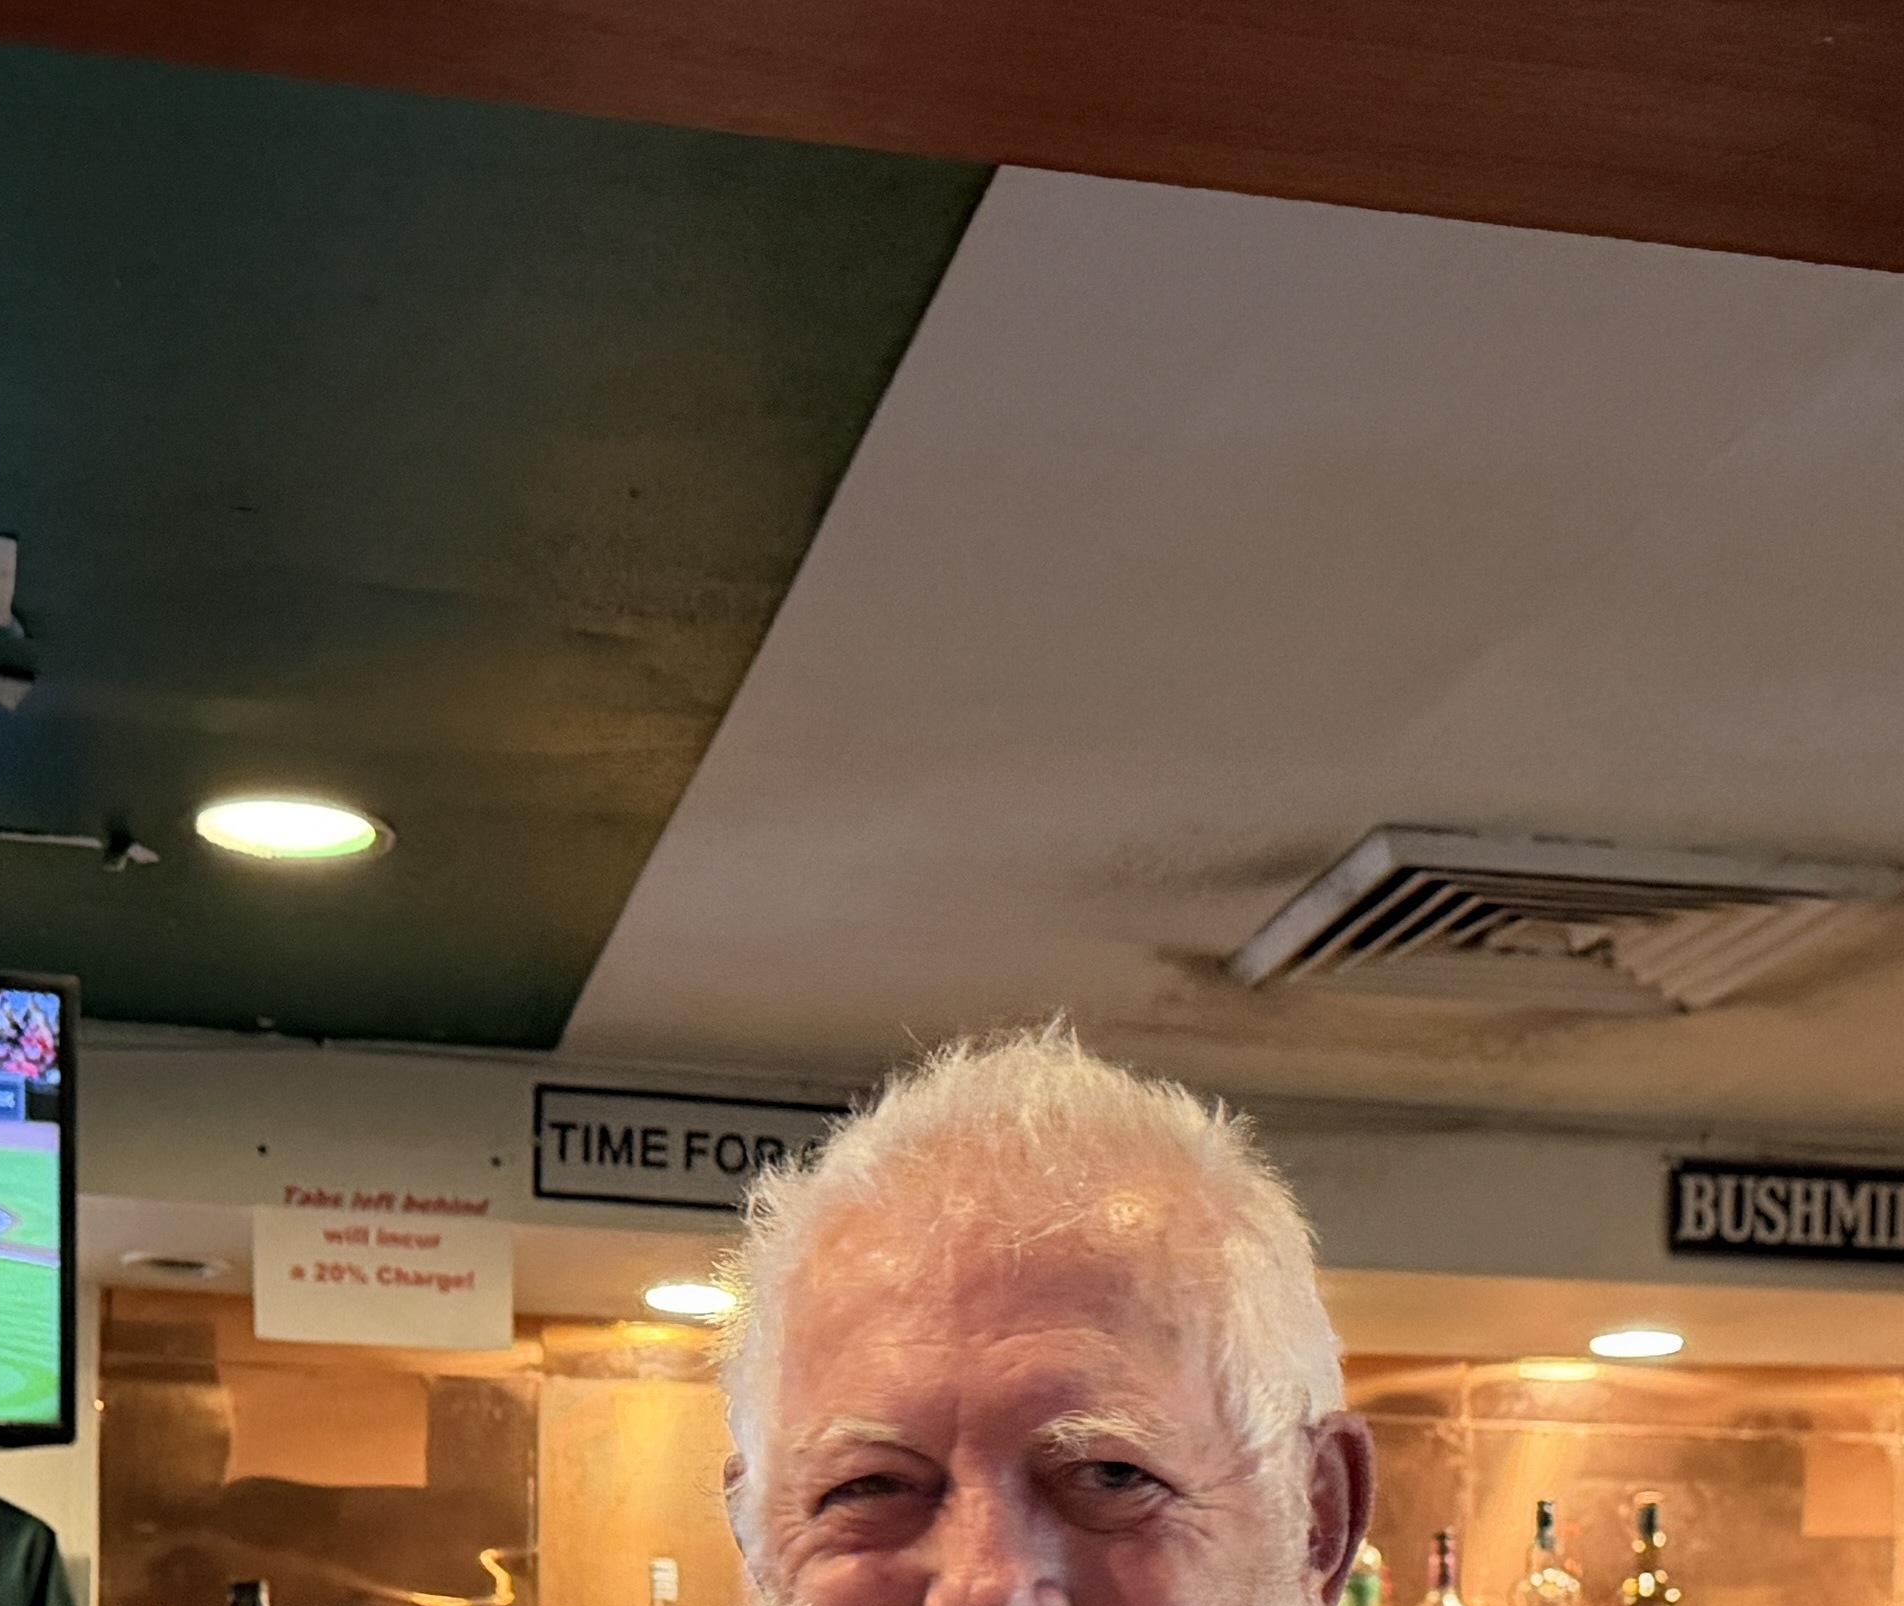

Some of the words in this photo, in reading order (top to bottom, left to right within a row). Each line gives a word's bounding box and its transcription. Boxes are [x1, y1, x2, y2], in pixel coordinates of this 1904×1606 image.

[549, 1121, 669, 1170] TIME
[685, 1130, 786, 1176] FOR
[401, 1187, 491, 1216] behind
[323, 1224, 370, 1247] will
[376, 1226, 442, 1249] incur
[314, 1260, 369, 1285] 20%
